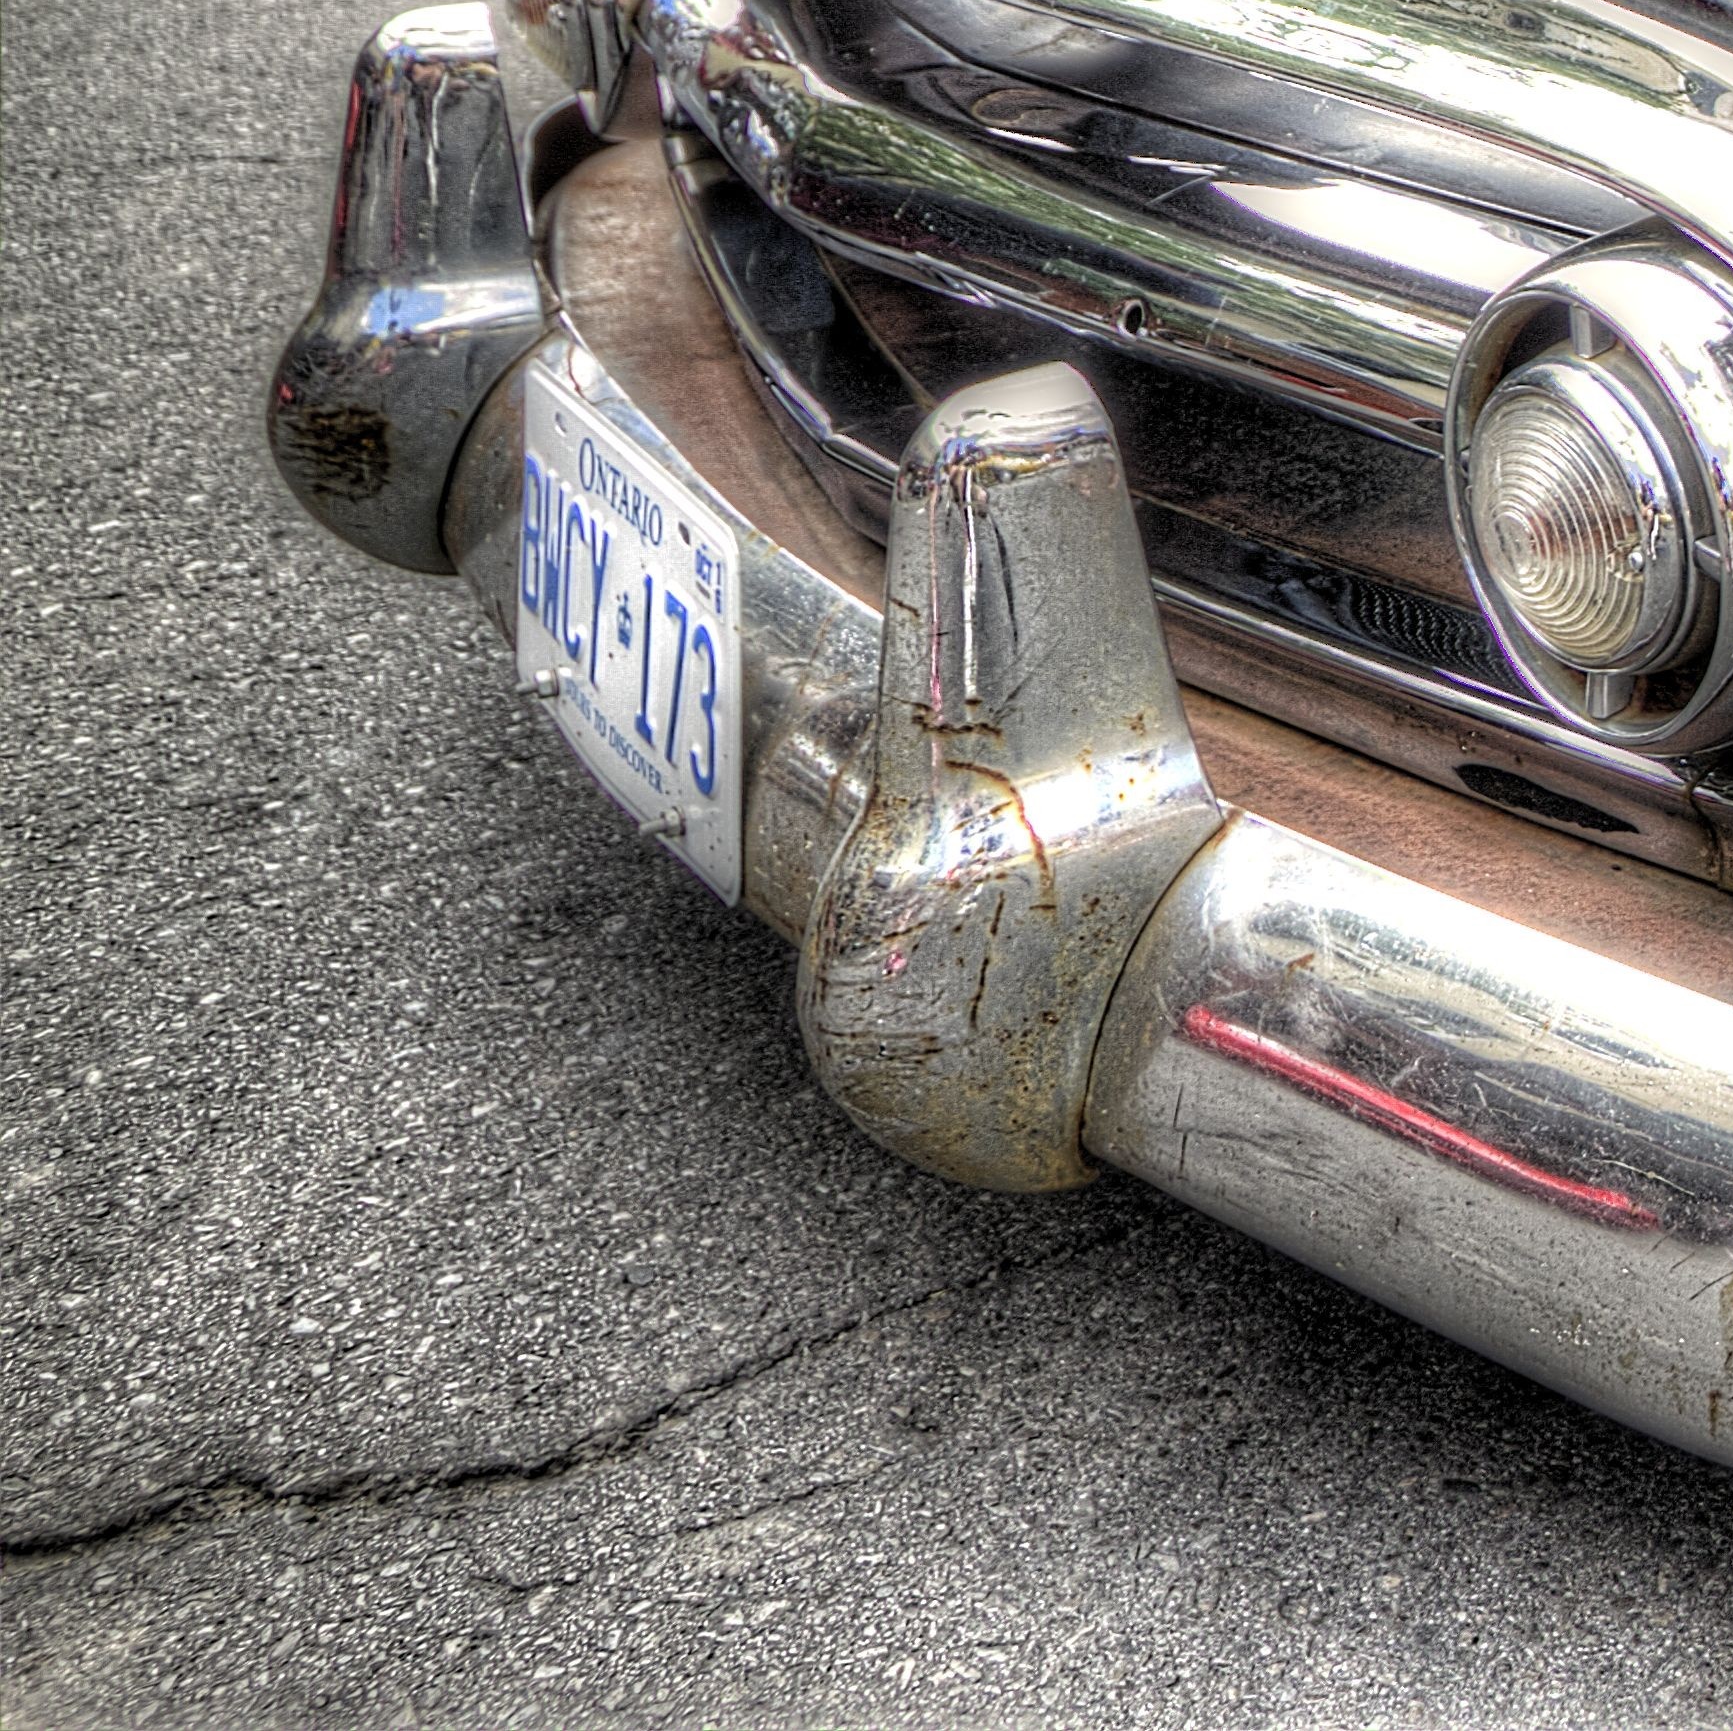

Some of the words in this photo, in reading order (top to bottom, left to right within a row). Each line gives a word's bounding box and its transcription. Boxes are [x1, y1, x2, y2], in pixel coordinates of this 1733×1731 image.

[579, 436, 664, 548] ONTARIO
[522, 452, 611, 688] BWCY
[635, 571, 719, 798] 173
[593, 707, 607, 738] TO
[608, 724, 663, 794] DISCOVER
